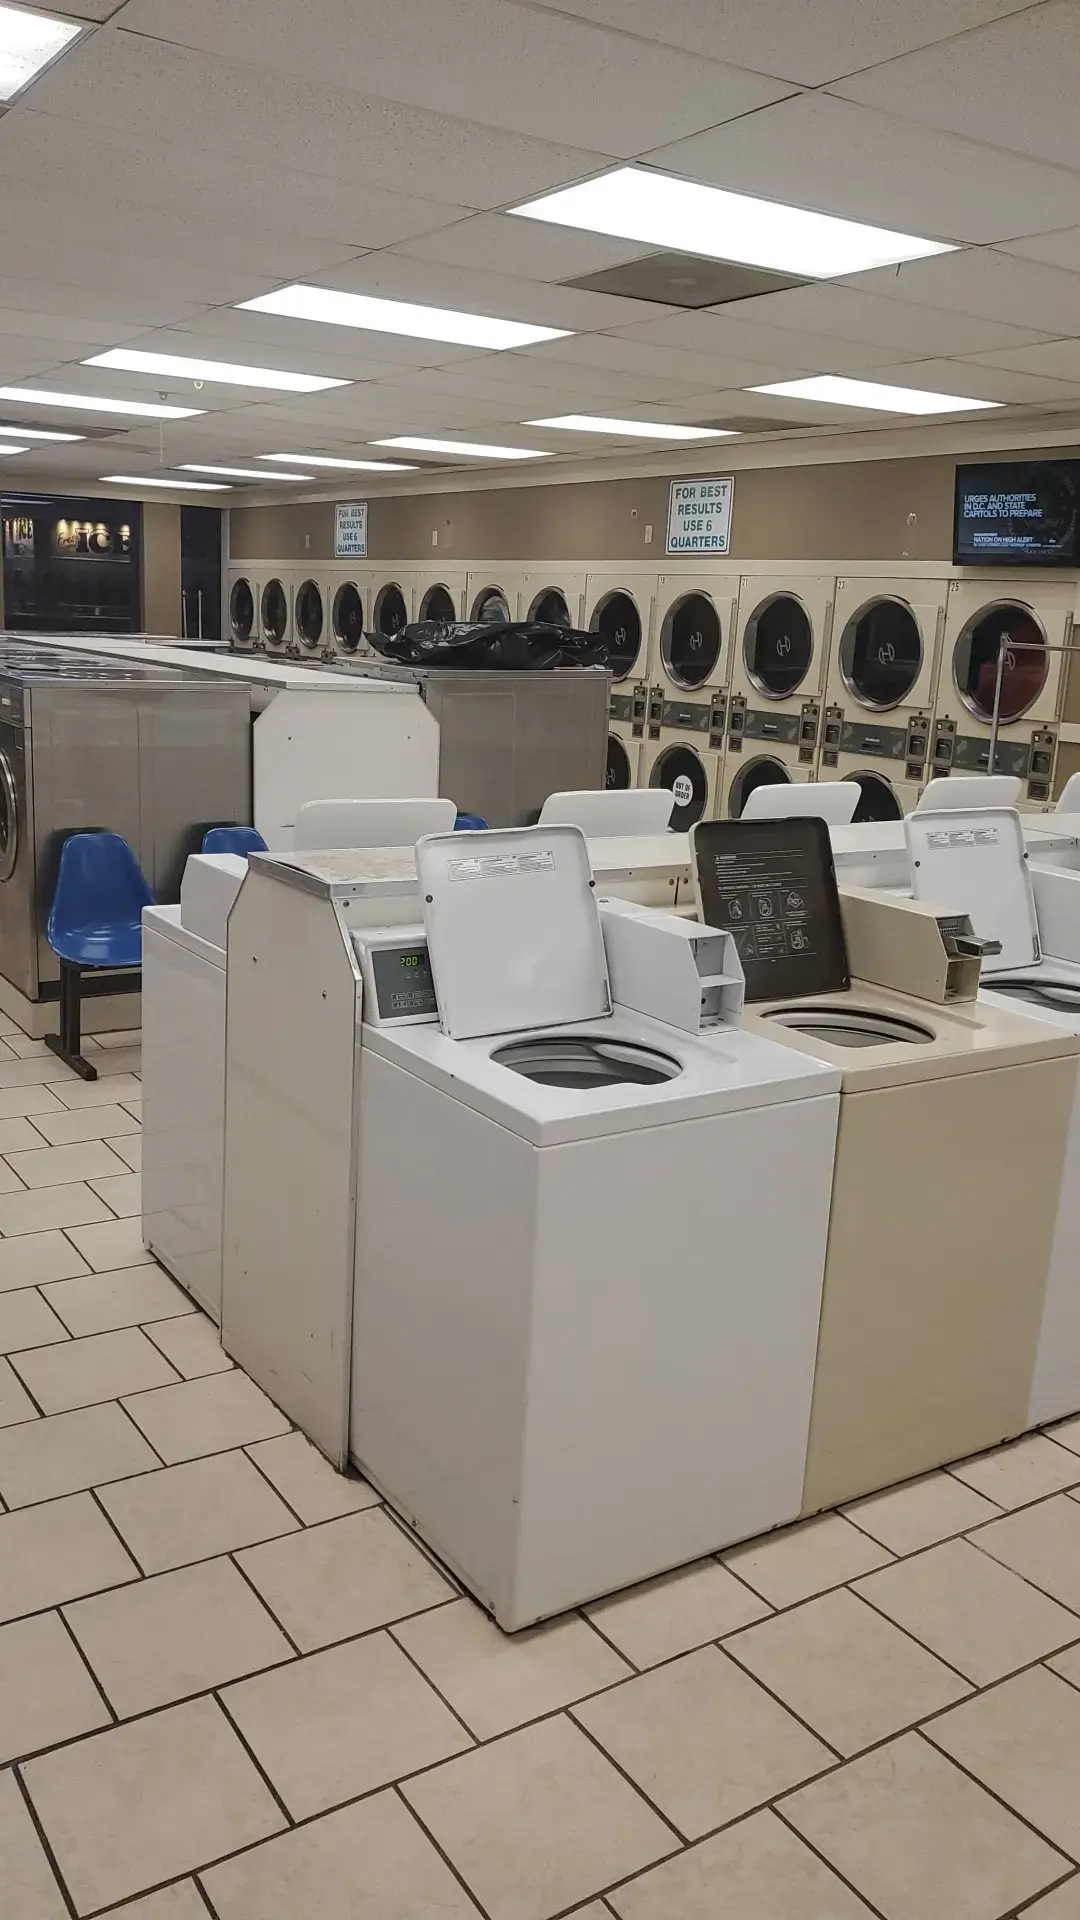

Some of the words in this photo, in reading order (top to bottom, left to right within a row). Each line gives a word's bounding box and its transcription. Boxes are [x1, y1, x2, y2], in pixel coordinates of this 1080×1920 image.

[676, 487, 696, 499] FOR
[700, 485, 728, 498] BEST
[964, 494, 988, 503] URGES
[989, 493, 1037, 502] AUTHORITIES
[678, 502, 722, 515] RESULTS
[964, 502, 972, 510] IN
[987, 502, 1003, 510] AND
[338, 510, 348, 518] FOR
[351, 509, 364, 517] BEST
[963, 510, 998, 518] CAPITOLS
[999, 509, 1009, 518] TO
[1009, 509, 1043, 517] PREPARE
[340, 520, 362, 529] RESULTS
[683, 519, 703, 532] USE
[706, 519, 713, 532] 6
[342, 532, 353, 541] USE
[353, 532, 358, 541] 6
[671, 535, 725, 548] QUARTERS
[338, 544, 364, 552] QUARTERS
[838, 580, 845, 590] 23
[951, 582, 960, 592] 25
[675, 781, 685, 790] OUT
[684, 783, 691, 792] OF
[674, 789, 690, 800] ORDER
